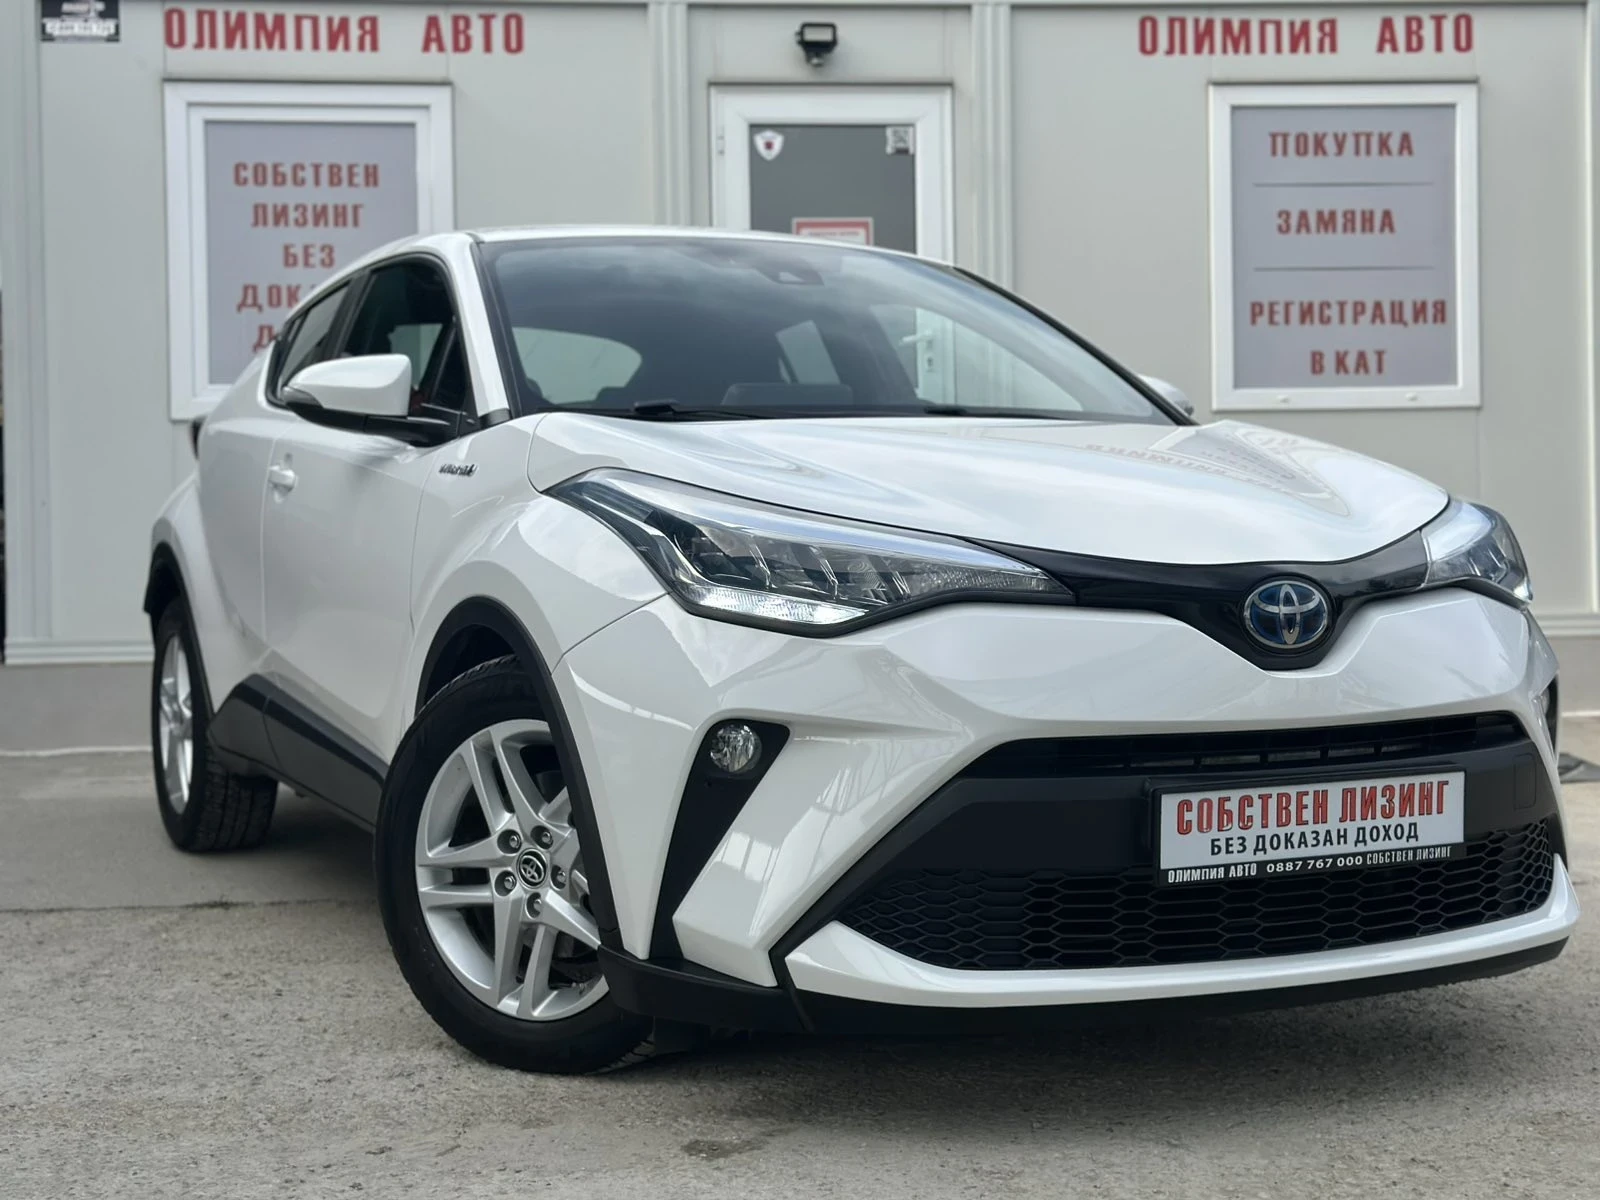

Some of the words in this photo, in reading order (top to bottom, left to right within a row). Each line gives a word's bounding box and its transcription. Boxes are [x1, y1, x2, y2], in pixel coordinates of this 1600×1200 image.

[164, 8, 380, 53] ОЛИМПИЯ
[421, 13, 525, 55] АВТО
[1138, 16, 1339, 56] ОЛИМПИЯ
[1376, 14, 1474, 54] АВТО
[1268, 131, 1415, 158] ПОКУПКА
[233, 162, 380, 189] СОБСТВЕН
[250, 203, 366, 229] ЛИЗИНГ
[1276, 209, 1396, 235] ЗАМЯНА
[282, 243, 336, 269] БЕЗ
[1249, 299, 1448, 327] РЕГИСТРАЦИЯ
[1310, 350, 1325, 376] В
[1334, 350, 1389, 376] КАТ
[1176, 789, 1329, 836] СОБСТВЕН
[1338, 780, 1450, 824] ЛИЗИНГ
[1210, 835, 1248, 856] БЕЗ
[1253, 830, 1349, 855] ДОКАЗАН
[1354, 822, 1420, 847] ДОХОД
[1168, 866, 1225, 884] ОЛИМПИЯ
[1229, 862, 1257, 878] АВТО
[1266, 860, 1302, 873] 0887
[1306, 857, 1333, 870] 767
[1336, 855, 1364, 868] 000
[1366, 850, 1414, 866] СОБСТВЕН
[1416, 845, 1452, 861] ЛИЗИНГ
